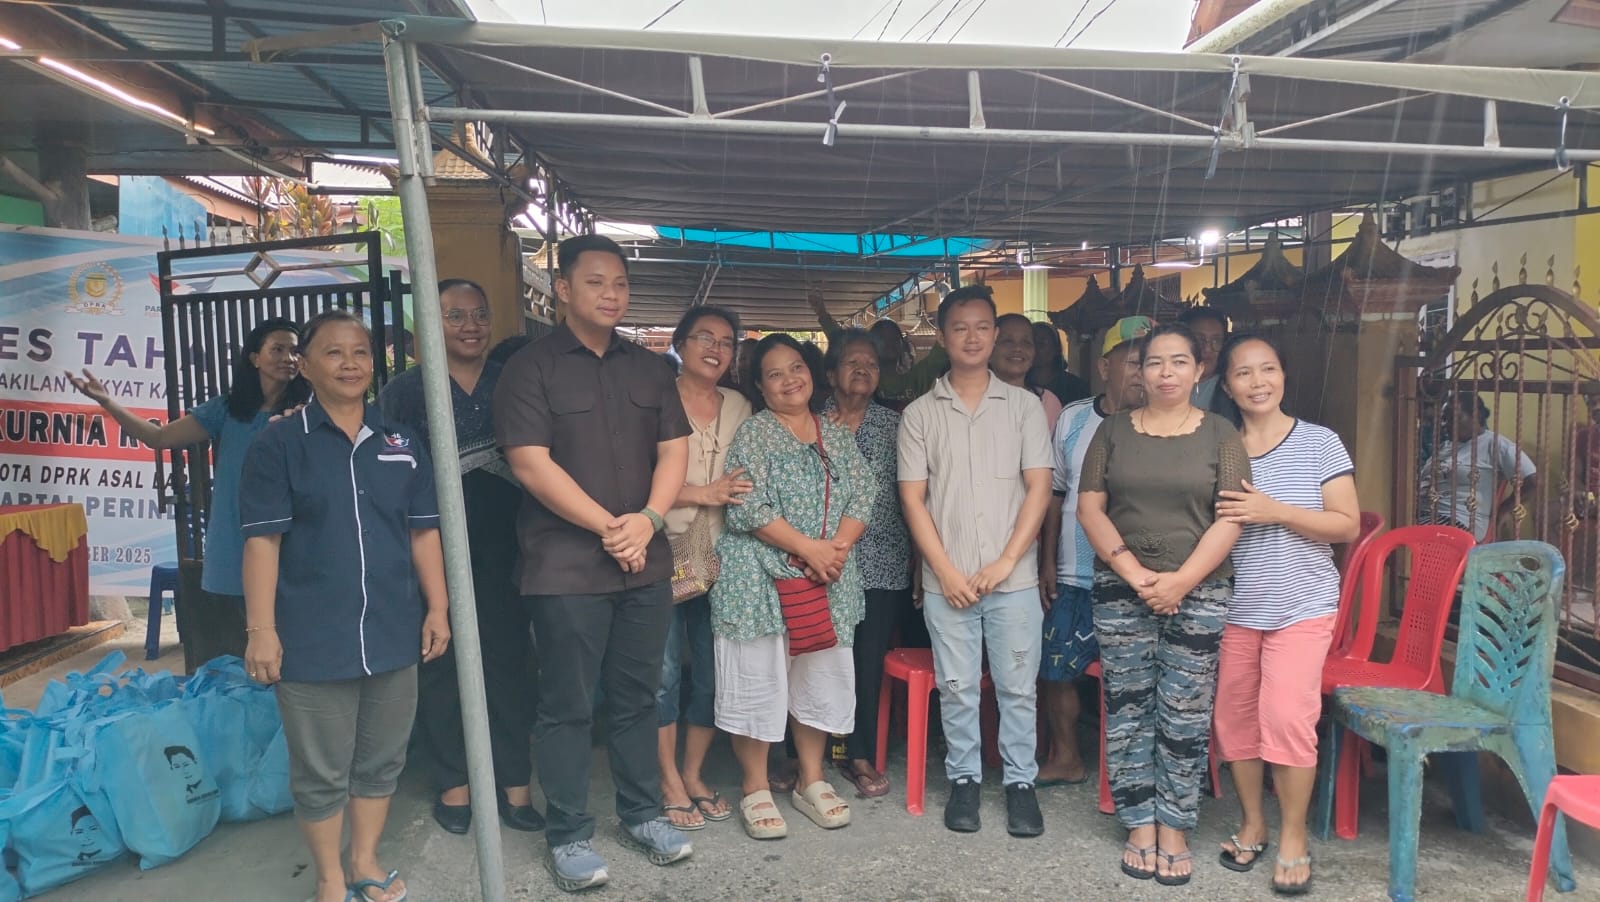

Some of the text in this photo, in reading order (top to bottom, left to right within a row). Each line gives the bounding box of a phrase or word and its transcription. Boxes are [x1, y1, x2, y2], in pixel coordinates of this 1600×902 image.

[0, 408, 107, 448] URNIA
[40, 466, 90, 486] DPRK
[97, 469, 143, 488] ASAL
[116, 547, 151, 564] 2025
